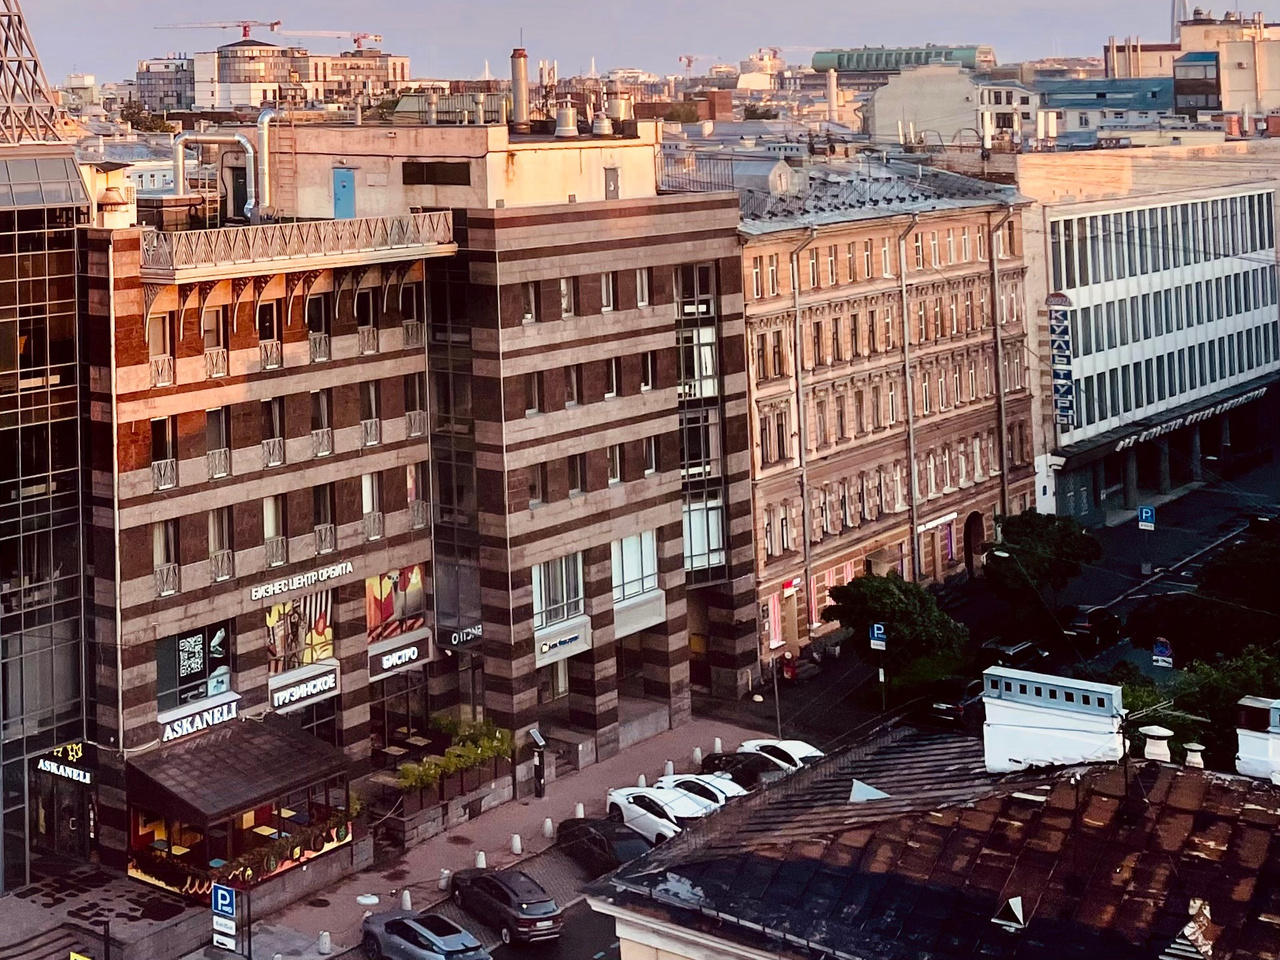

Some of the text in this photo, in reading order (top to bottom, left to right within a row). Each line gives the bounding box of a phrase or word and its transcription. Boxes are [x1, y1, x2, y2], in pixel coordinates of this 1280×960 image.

[1051, 310, 1072, 424] КУЛЬТУРЫ
[1142, 508, 1151, 519] P
[251, 561, 353, 600] БИЗНЕС ЦЕНТР ОРБИТА
[874, 623, 884, 638] P
[381, 646, 418, 669] БИСТРО
[273, 673, 336, 707] ГРУЗИНСКОЕ
[162, 701, 237, 742] ASKANELI
[37, 758, 91, 784] ASKANELI
[217, 889, 231, 911] P
